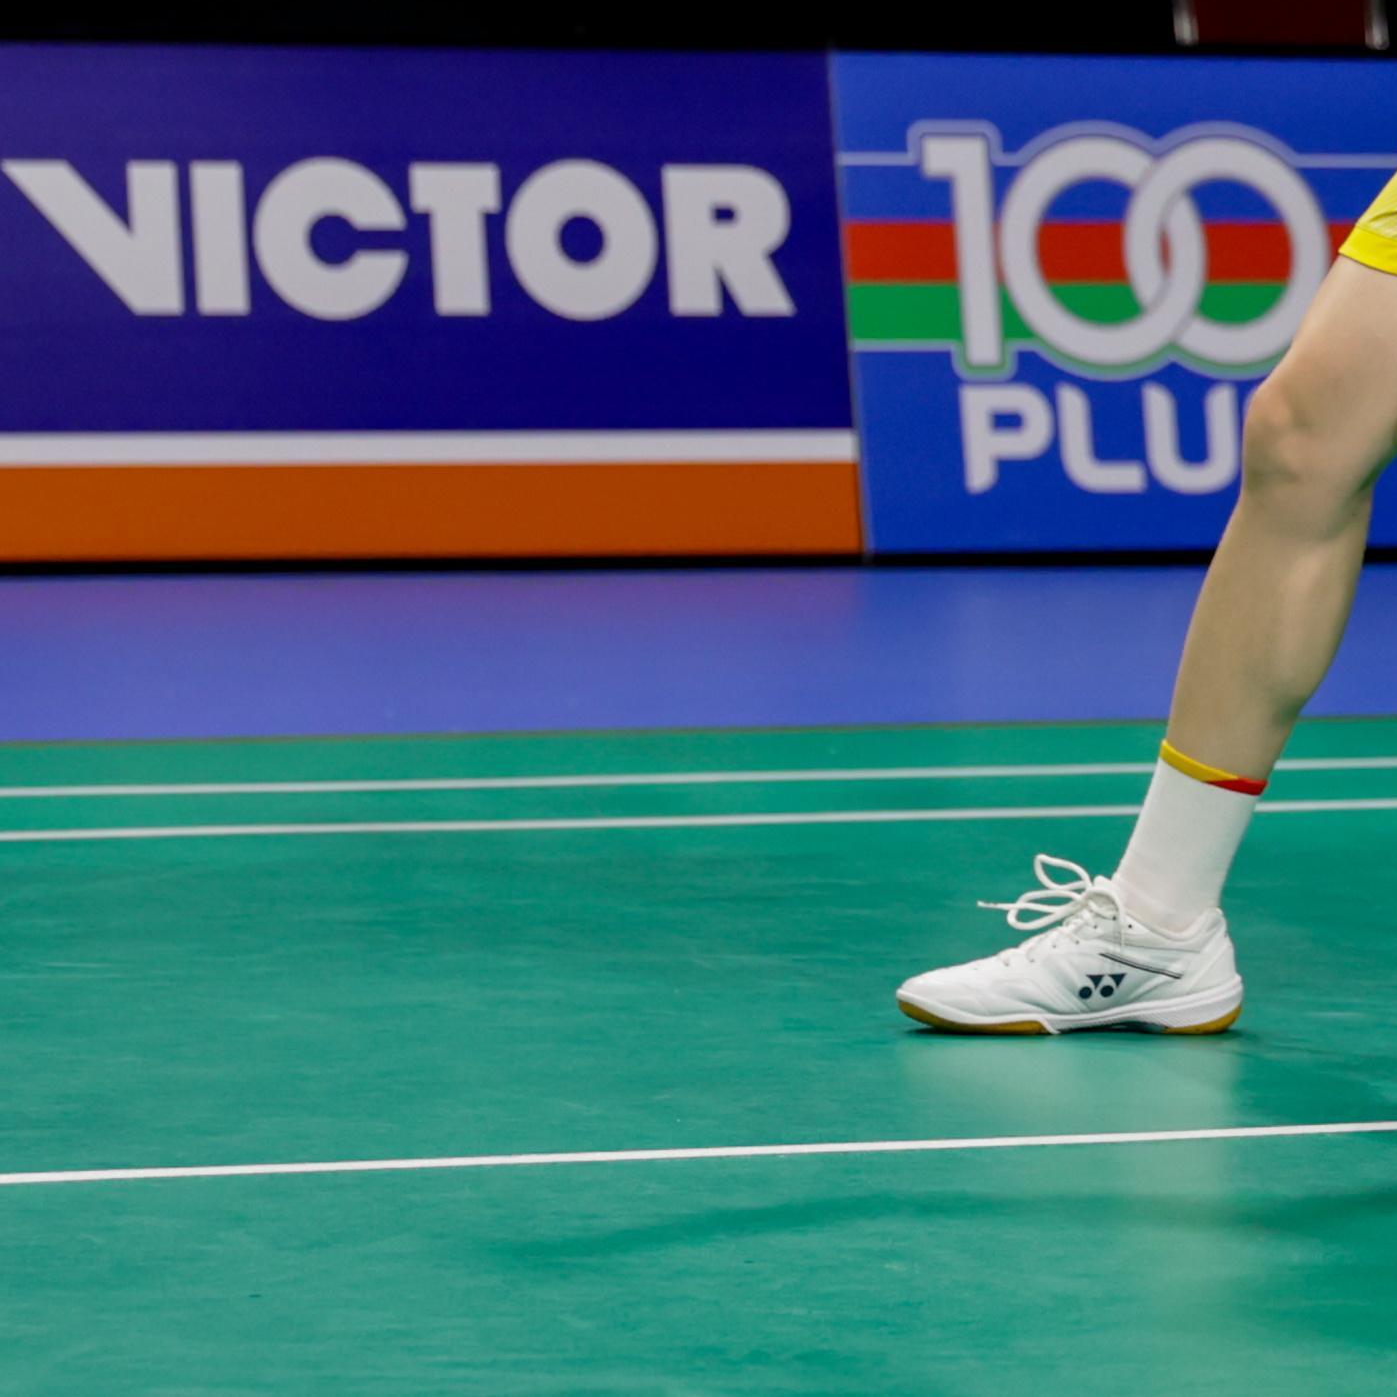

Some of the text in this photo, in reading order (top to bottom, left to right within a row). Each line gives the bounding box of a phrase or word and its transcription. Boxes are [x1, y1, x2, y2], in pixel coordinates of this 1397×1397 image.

[2, 157, 796, 321] VICTOR
[921, 135, 1332, 367] 100
[961, 382, 1250, 494] PLU
